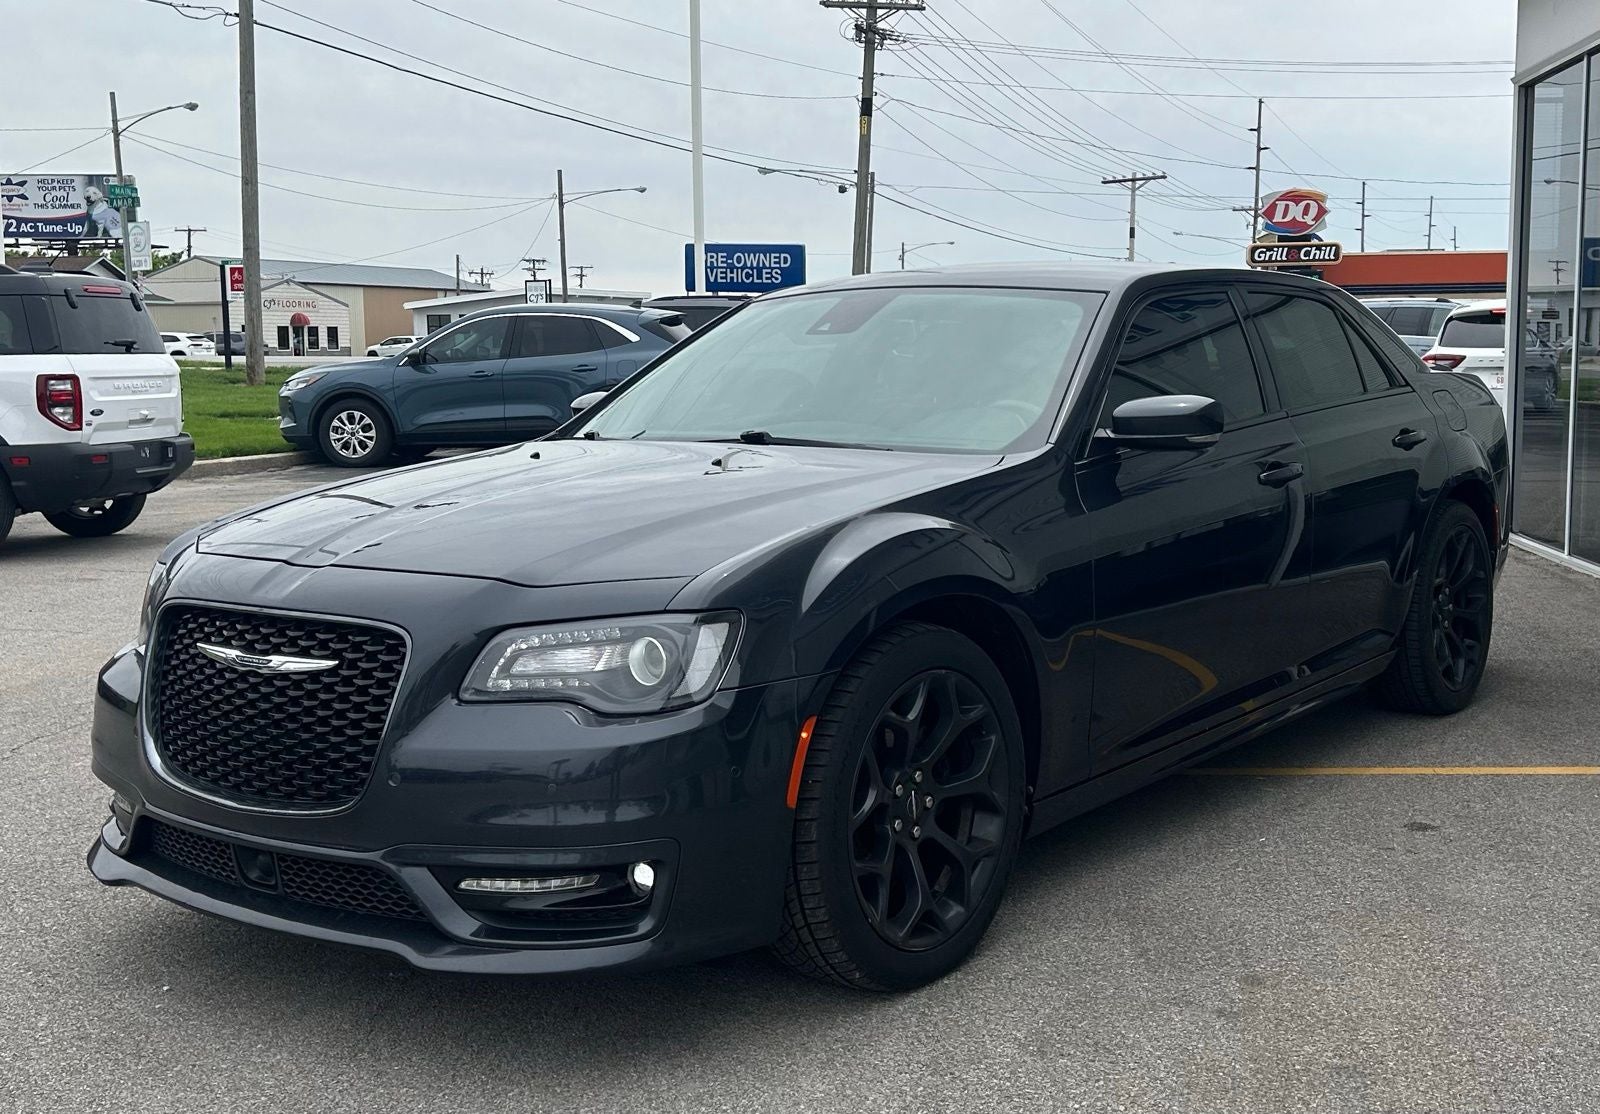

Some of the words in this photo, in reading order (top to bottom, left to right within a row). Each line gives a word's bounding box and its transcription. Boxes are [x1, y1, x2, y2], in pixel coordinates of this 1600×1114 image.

[43, 192, 69, 202] Cool
[115, 187, 131, 195] MAIN
[108, 198, 133, 208] LAMAR
[1272, 200, 1318, 225] DQ
[20, 223, 35, 232] AC
[36, 222, 82, 234] Tune-Up
[705, 252, 792, 267] RE-OWNED
[1254, 247, 1288, 261] Grill
[1288, 249, 1300, 260] &
[1300, 246, 1336, 260] Chill
[707, 269, 782, 283] VEHICLES
[277, 300, 317, 309] FLOORING
